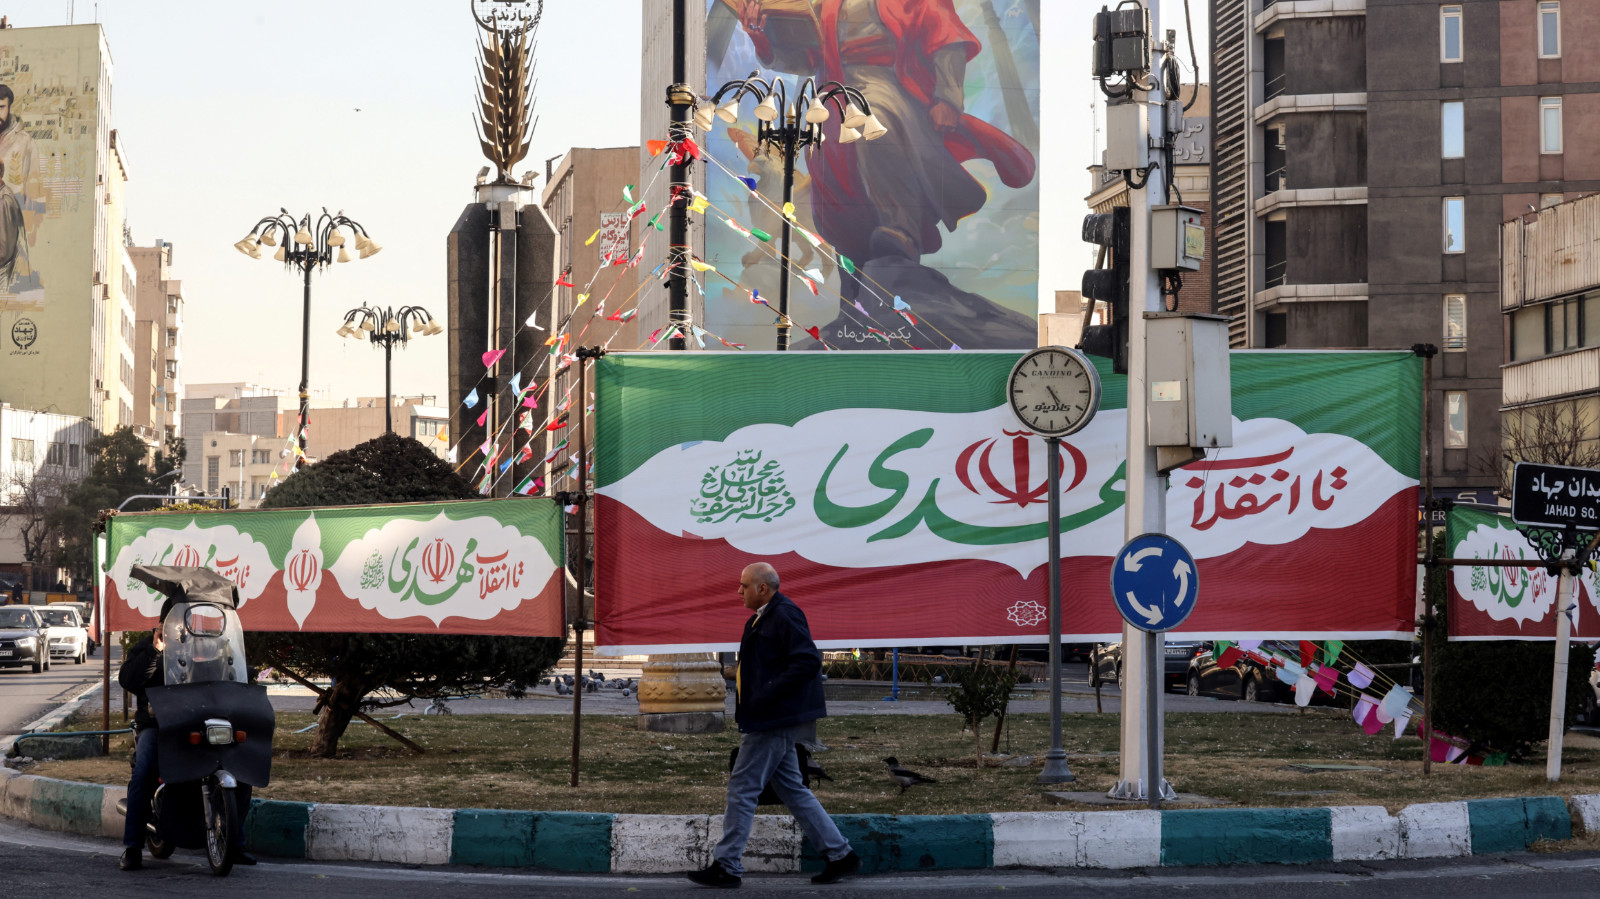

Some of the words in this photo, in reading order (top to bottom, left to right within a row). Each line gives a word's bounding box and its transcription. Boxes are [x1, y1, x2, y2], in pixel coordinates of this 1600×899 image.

[1179, 446, 1301, 531] انقلاب
[1312, 466, 1348, 511] تا
[1532, 472, 1565, 500] جهاد
[1568, 476, 1600, 504] یدان
[1545, 505, 1576, 518] JAHAD
[1581, 506, 1598, 520] SQ.
[388, 536, 478, 605] مهدی
[476, 549, 510, 600] انقلاب
[512, 561, 524, 588] تا
